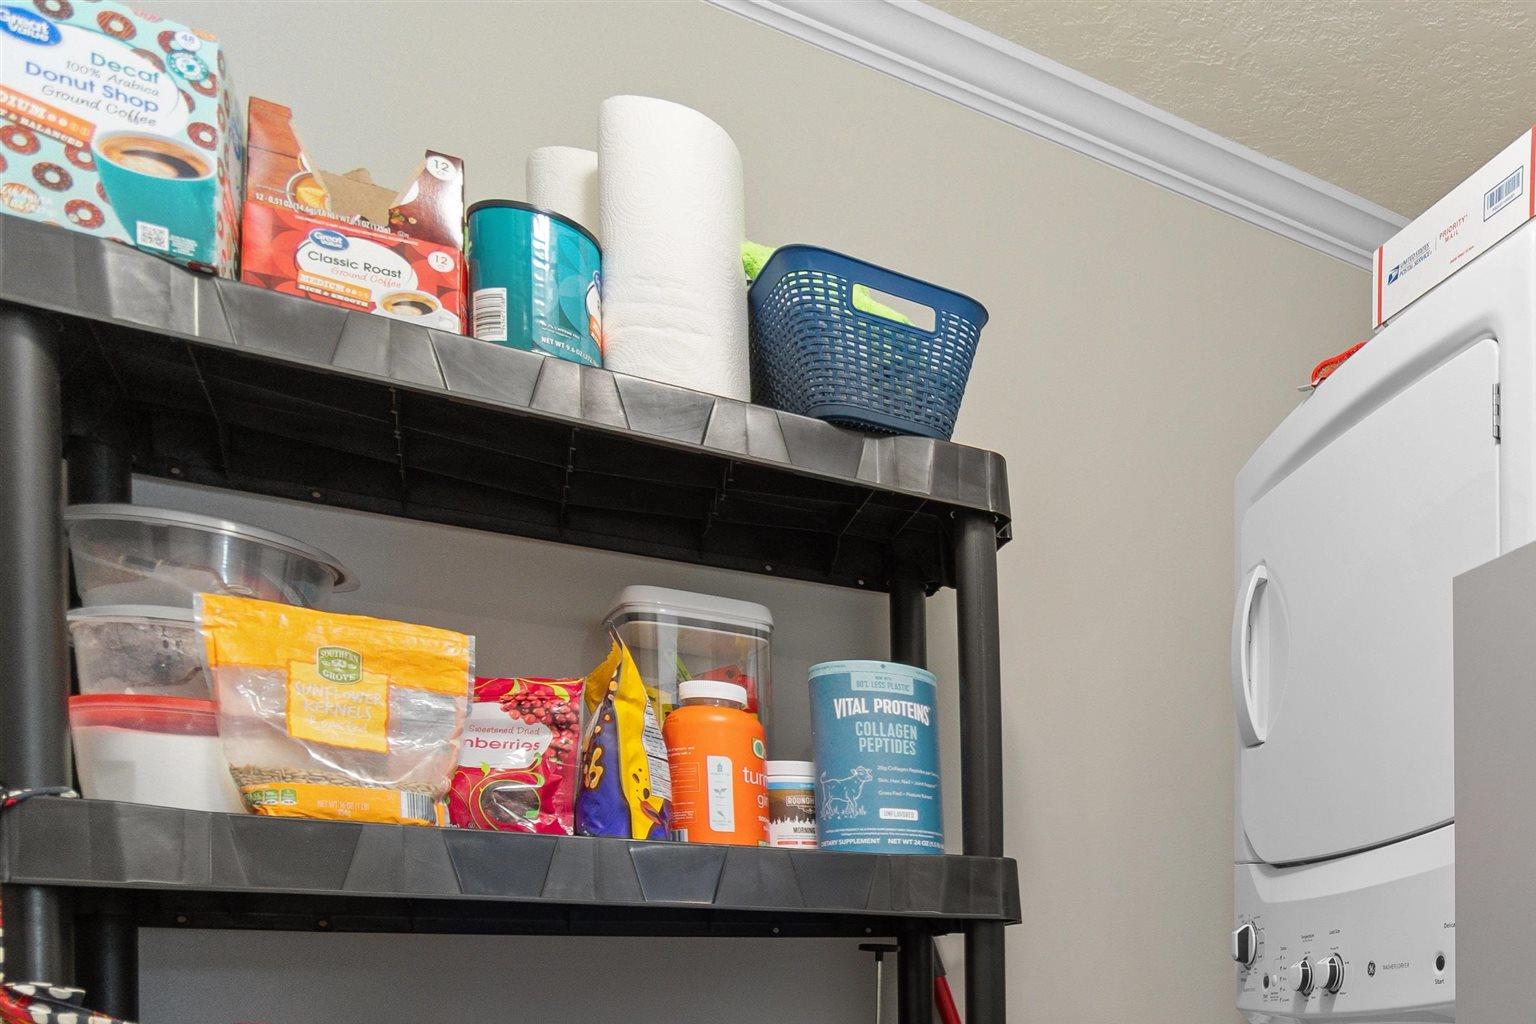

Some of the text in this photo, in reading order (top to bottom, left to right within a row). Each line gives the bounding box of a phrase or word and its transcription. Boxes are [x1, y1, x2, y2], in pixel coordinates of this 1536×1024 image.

[91, 53, 160, 84] Decaf
[26, 61, 159, 113] Donut Shop
[66, 61, 160, 97] 100% Arabica
[41, 84, 157, 127] Ground Coffee
[433, 159, 450, 171] 12
[1439, 215, 1468, 240] PRIORITY
[1445, 230, 1460, 243] MAIL
[313, 230, 343, 246] Great
[308, 250, 402, 279] Classic Roast
[434, 255, 449, 266] 12
[1400, 251, 1416, 269] UNITED
[331, 266, 401, 288] Ground Coffee
[1399, 262, 1413, 277] POSTAL
[541, 336, 555, 346] NET
[555, 340, 565, 349] WT
[319, 649, 361, 664] SOUTHERN
[322, 669, 356, 682] GROVE
[294, 681, 384, 706] SUNFLOWER
[871, 680, 886, 689] LESS
[887, 682, 911, 692] PLASTIC
[302, 701, 373, 721] KERNELS
[833, 698, 930, 727] VITAL PROTEINS
[468, 724, 541, 736] Sweetened Dried
[855, 721, 918, 741] COLLAGEN
[464, 738, 541, 752] nberries
[859, 737, 917, 756] PEPTIDES
[902, 838, 913, 846] WT
